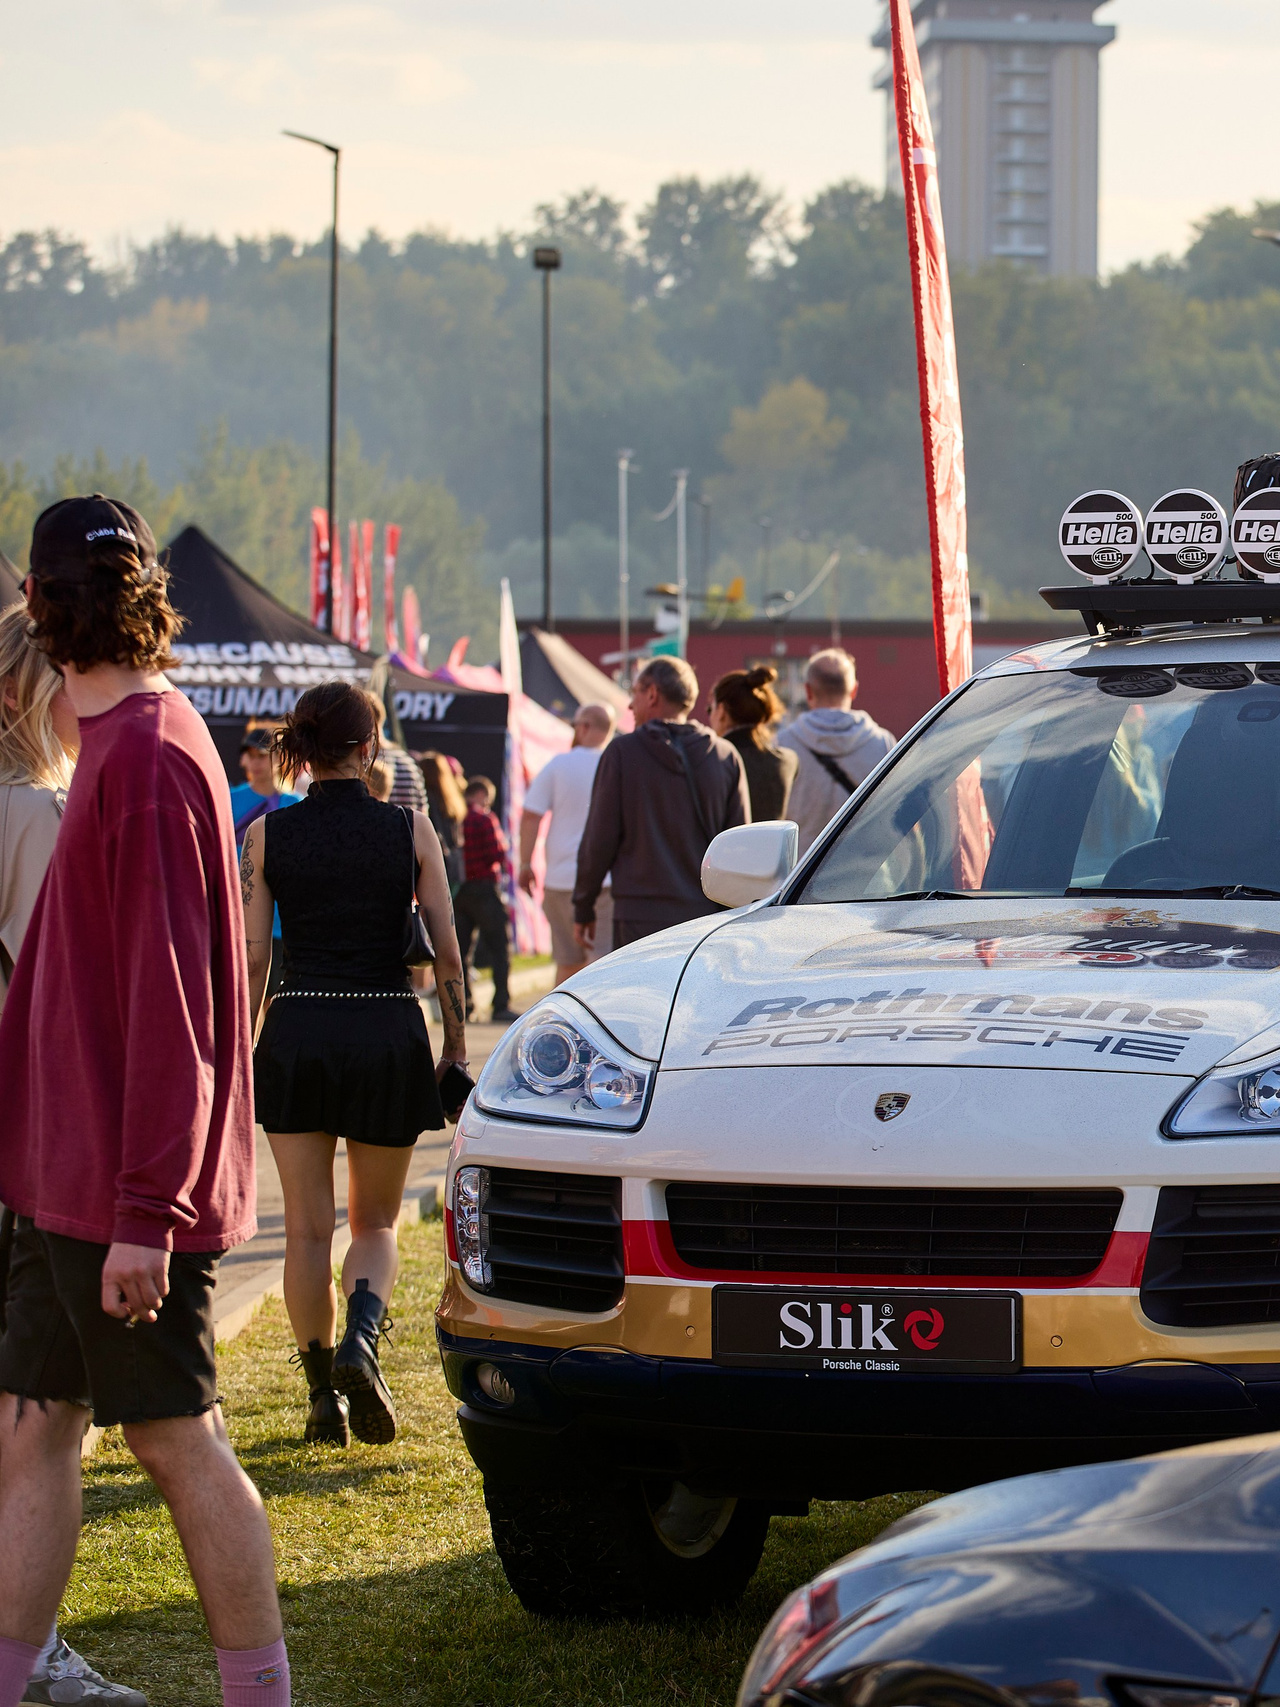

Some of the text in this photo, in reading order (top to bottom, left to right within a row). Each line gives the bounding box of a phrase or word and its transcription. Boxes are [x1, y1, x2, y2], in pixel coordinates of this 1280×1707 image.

[1116, 513, 1133, 521] 500
[1200, 512, 1218, 520] 500
[1066, 523, 1134, 545] Hella
[1150, 522, 1218, 544] Hella
[1094, 553, 1123, 562] HELLA
[1179, 552, 1207, 561] HELLA
[172, 640, 358, 667] BECAUSE
[166, 665, 262, 684] WHY
[726, 987, 1210, 1032] Rothmans
[701, 1025, 1191, 1062] PORSCHE
[822, 1358, 900, 1371] Porsche Classic
